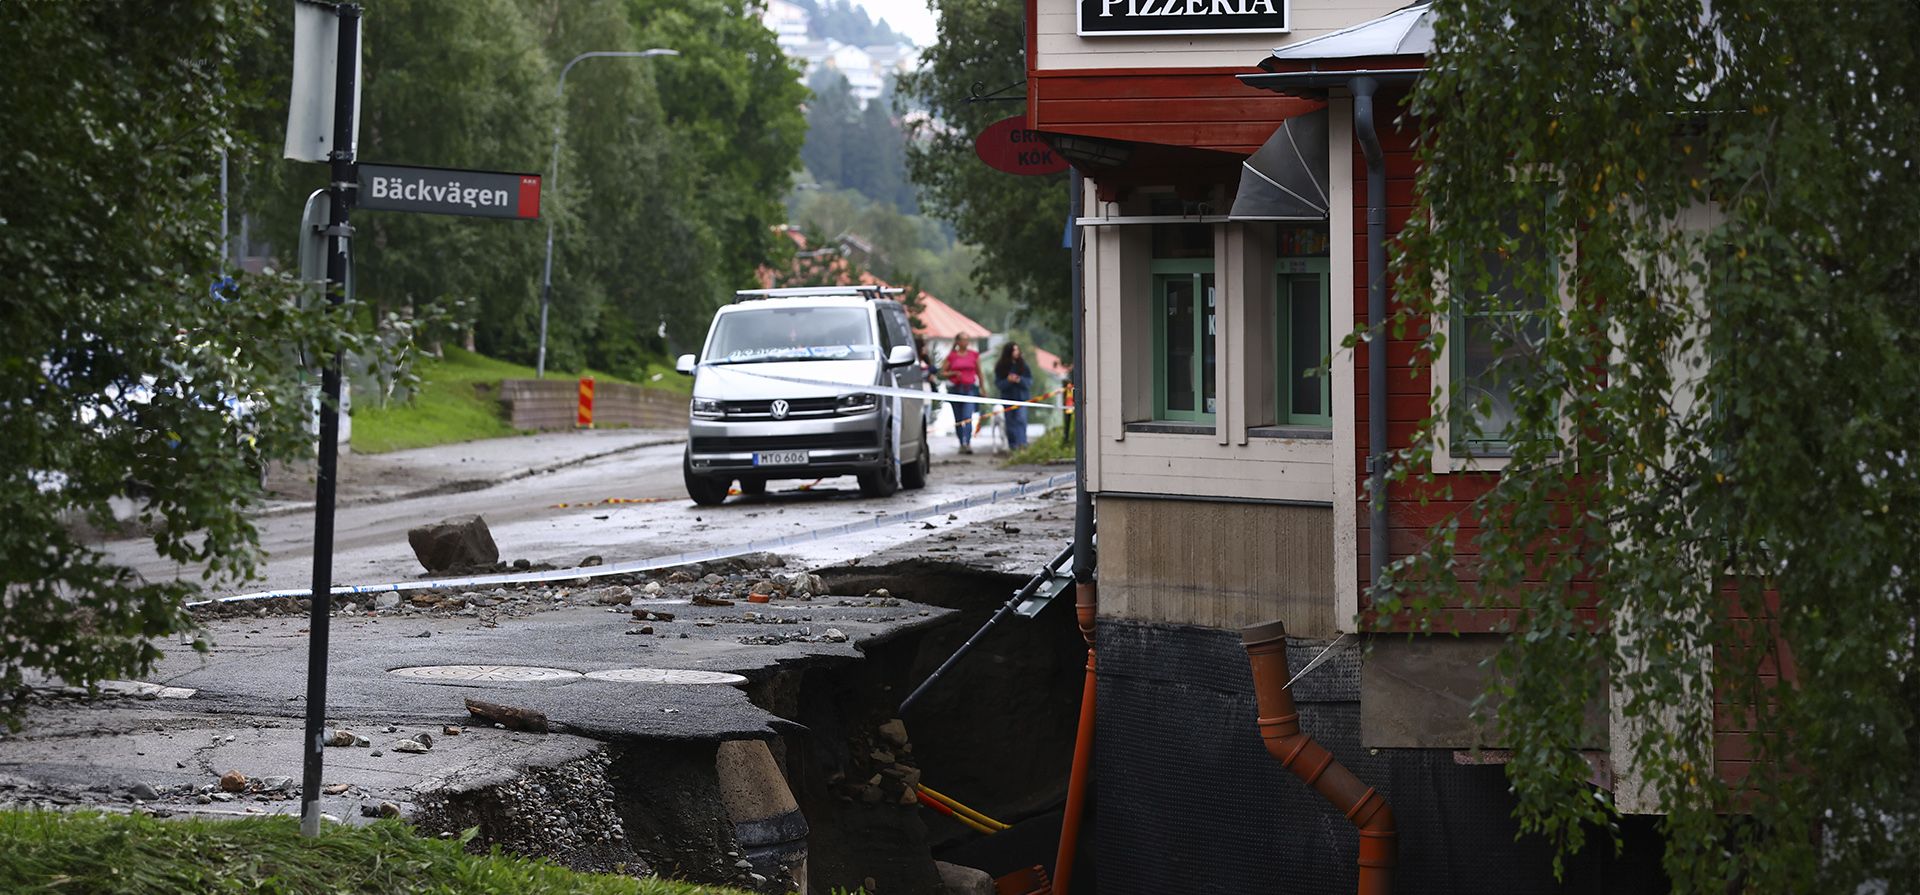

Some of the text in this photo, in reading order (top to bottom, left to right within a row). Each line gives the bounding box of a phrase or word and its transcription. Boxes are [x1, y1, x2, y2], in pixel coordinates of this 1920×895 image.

[1099, 0, 1277, 17] PIZZERIA
[372, 177, 508, 208] Bäckvägen
[761, 452, 804, 463] MTO 606
